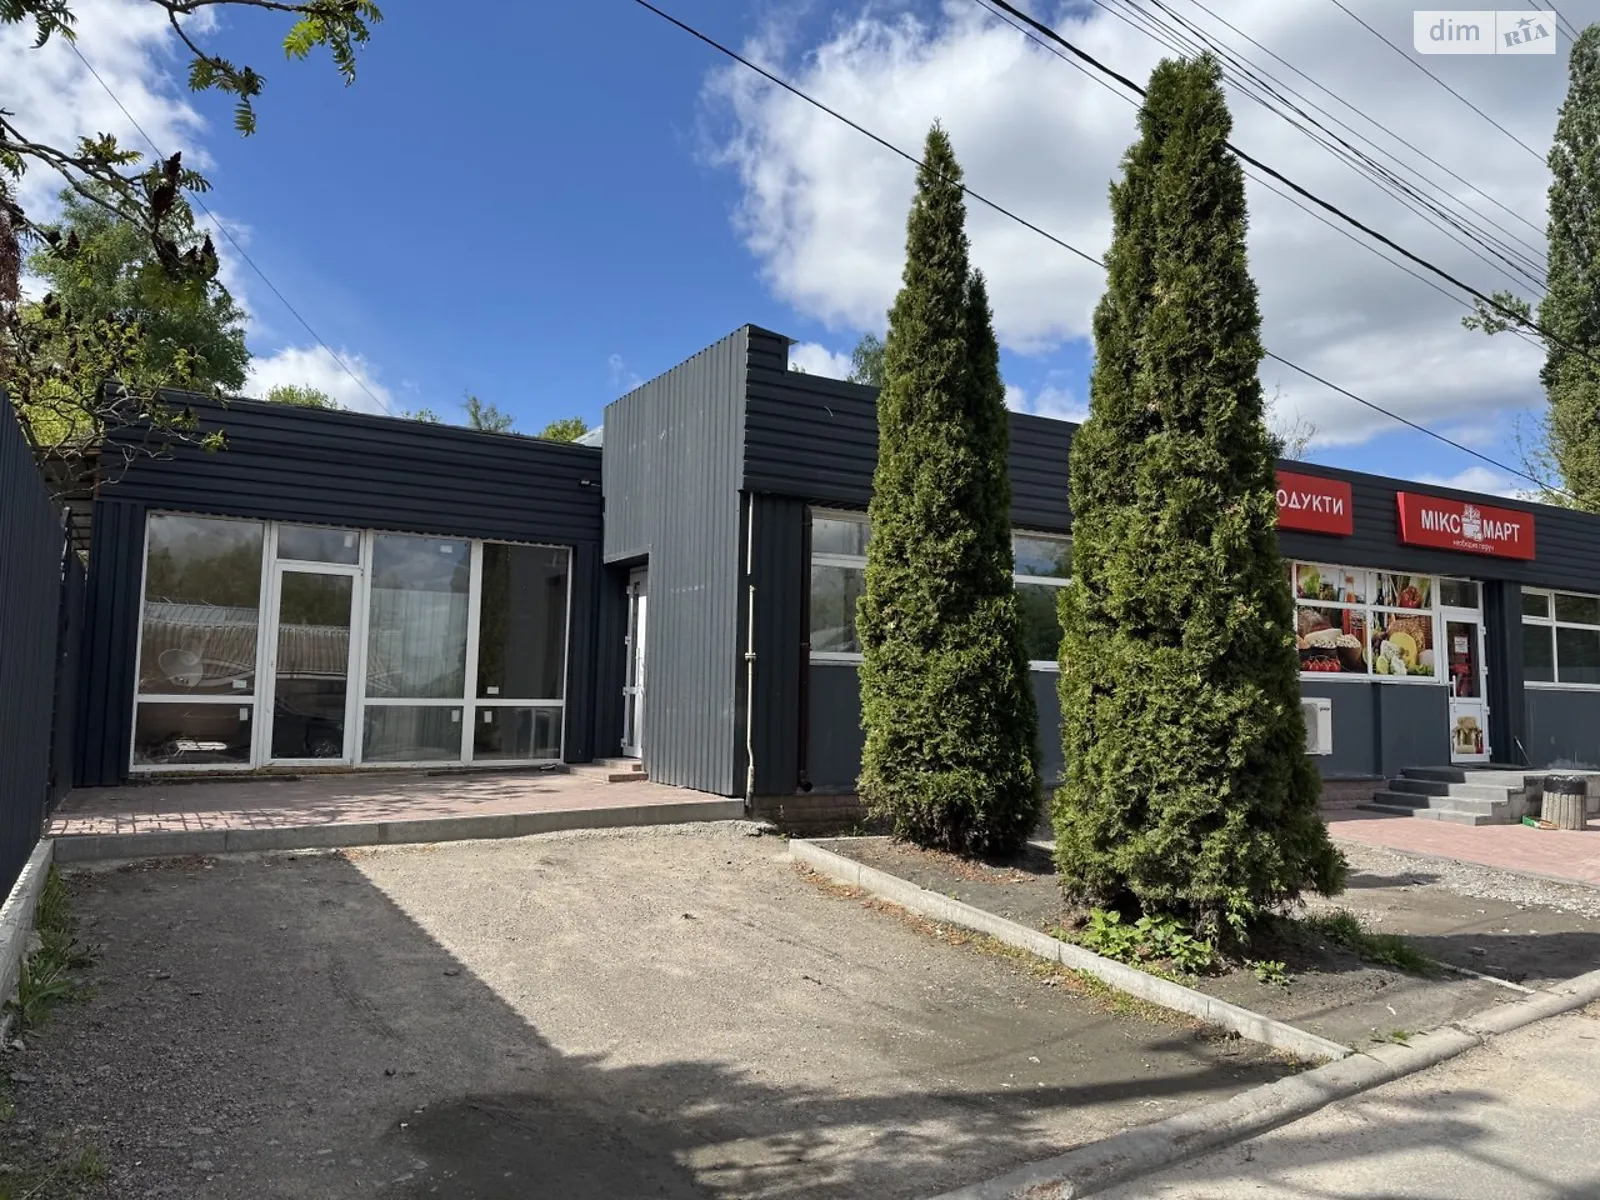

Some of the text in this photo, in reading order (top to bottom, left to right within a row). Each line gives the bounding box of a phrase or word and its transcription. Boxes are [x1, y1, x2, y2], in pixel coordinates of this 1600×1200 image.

[1275, 489, 1343, 515] ОДУКТИ
[1421, 510, 1520, 542] МІКС МАРТ
